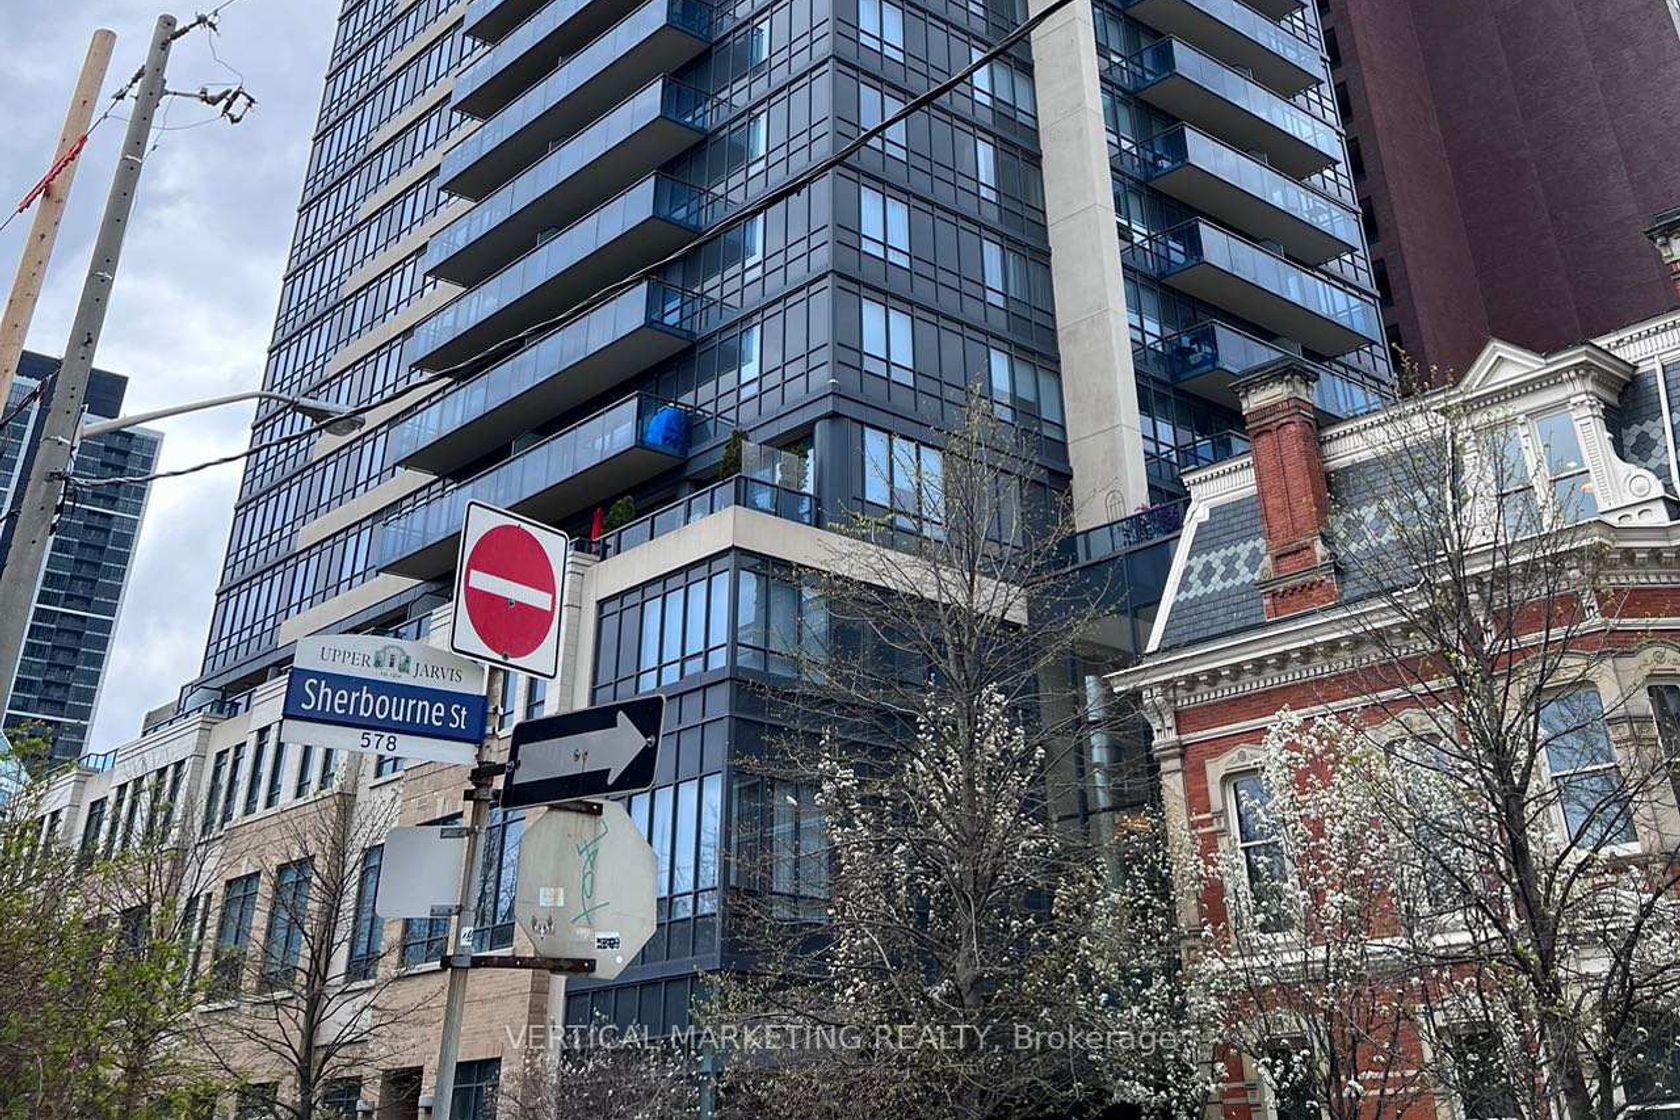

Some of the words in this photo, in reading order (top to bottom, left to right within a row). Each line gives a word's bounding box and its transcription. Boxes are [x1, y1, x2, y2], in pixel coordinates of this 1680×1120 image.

[320, 646, 371, 668] UPPER
[413, 662, 463, 683] JARVIS
[301, 678, 445, 726] Sherbourne
[449, 704, 468, 729] St
[360, 731, 398, 751] 578
